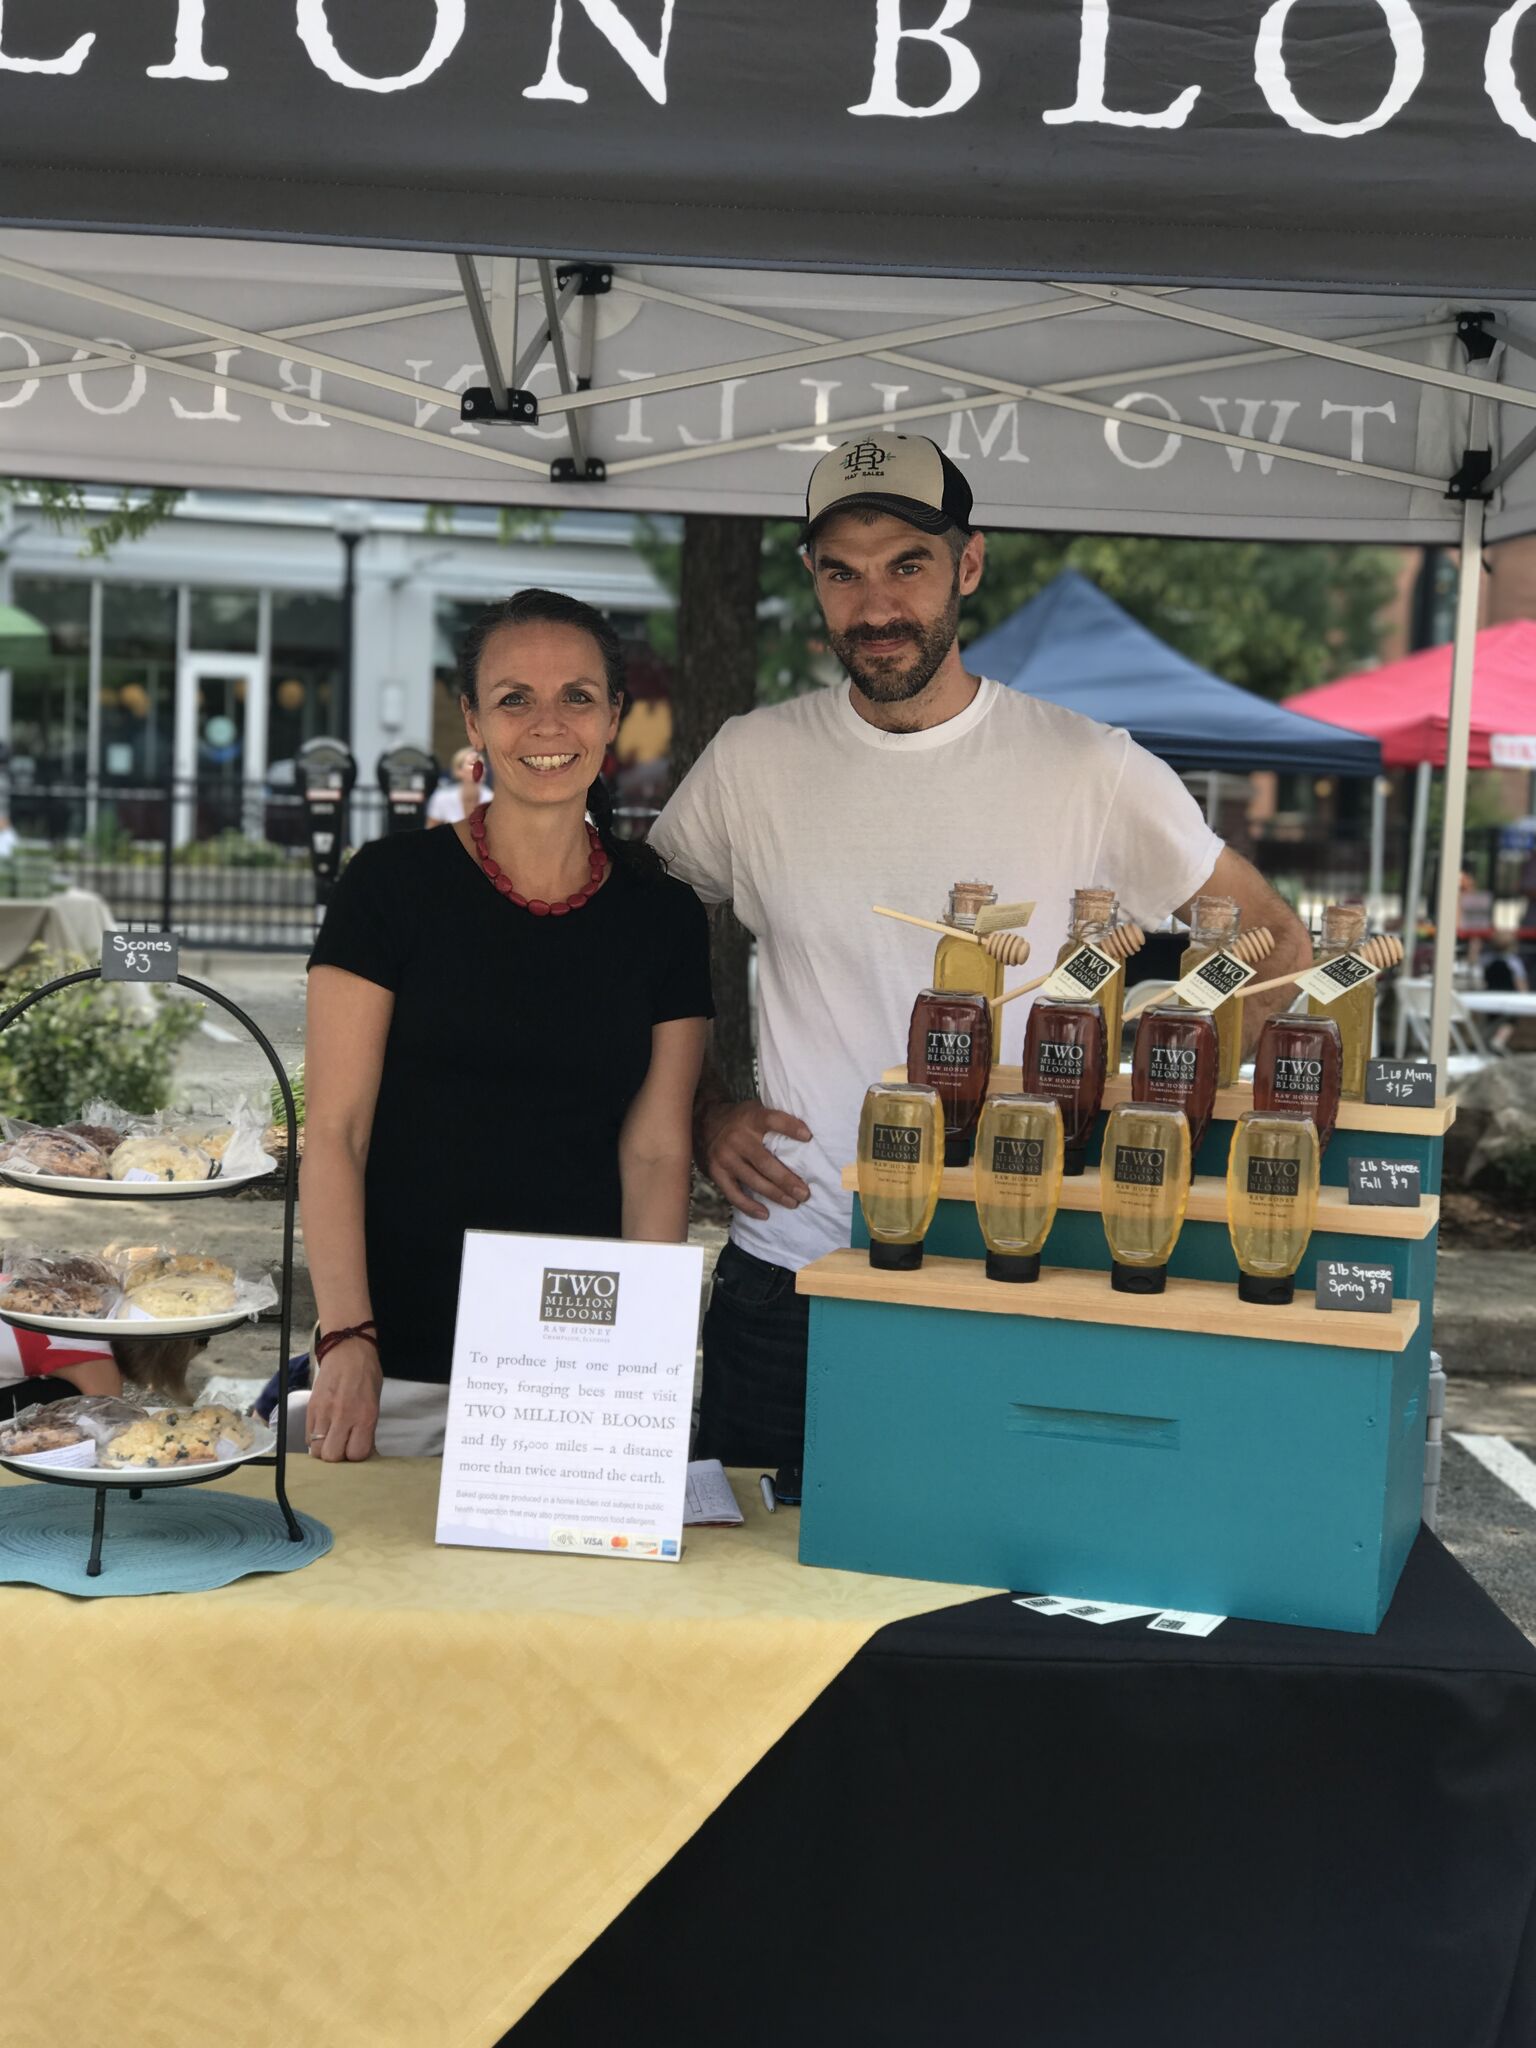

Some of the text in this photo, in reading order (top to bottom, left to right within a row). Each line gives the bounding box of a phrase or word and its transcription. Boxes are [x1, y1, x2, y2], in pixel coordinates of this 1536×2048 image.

[844, 472, 858, 481] HAY
[113, 935, 172, 952] Scones
[124, 951, 151, 973] $3
[1079, 949, 1110, 976] TWO
[1213, 955, 1245, 982] TWO
[1339, 956, 1369, 978] TWO
[1067, 964, 1096, 988] BLOOMS
[1200, 968, 1231, 992] BLOOMS
[1324, 966, 1352, 986] BLOOMS
[928, 1032, 971, 1048] TWO
[928, 1047, 969, 1056] MILLION
[928, 1054, 969, 1063] BLOOMS
[1041, 1043, 1083, 1060] TWO
[1152, 1048, 1196, 1065] TWO
[1040, 1058, 1082, 1067] MILLION
[1040, 1065, 1082, 1075] BLOOMS
[1277, 1059, 1321, 1076] TWO
[1151, 1070, 1194, 1080] BLOOMS
[1276, 1074, 1320, 1084] MILLION
[1276, 1081, 1320, 1091] BLOOMS
[1386, 1082, 1414, 1098] $15
[875, 1127, 919, 1145] TWO
[996, 1140, 1041, 1157] TWO
[1118, 1149, 1163, 1167] TWO
[1251, 1159, 1298, 1177] TWO
[1360, 1177, 1381, 1189] Fall
[547, 1272, 616, 1297] TWO
[1329, 1279, 1386, 1301] Spring $9
[545, 1296, 613, 1308] MILLION
[544, 1307, 612, 1320] BLOOMS
[543, 1325, 611, 1336] RAW HONEY
[469, 1351, 683, 1376] To produce just one pound of
[466, 1376, 677, 1402] honey, foraging bees must visit
[464, 1403, 676, 1429] TWO MILLION BLOOMS
[461, 1433, 484, 1446] and
[490, 1434, 507, 1451] fly
[512, 1440, 549, 1452] 55,000
[555, 1438, 588, 1452] miles
[609, 1445, 616, 1455] a
[623, 1443, 673, 1458] distance
[459, 1460, 665, 1484] more than twice around the earth.
[583, 1536, 603, 1547] VISA
